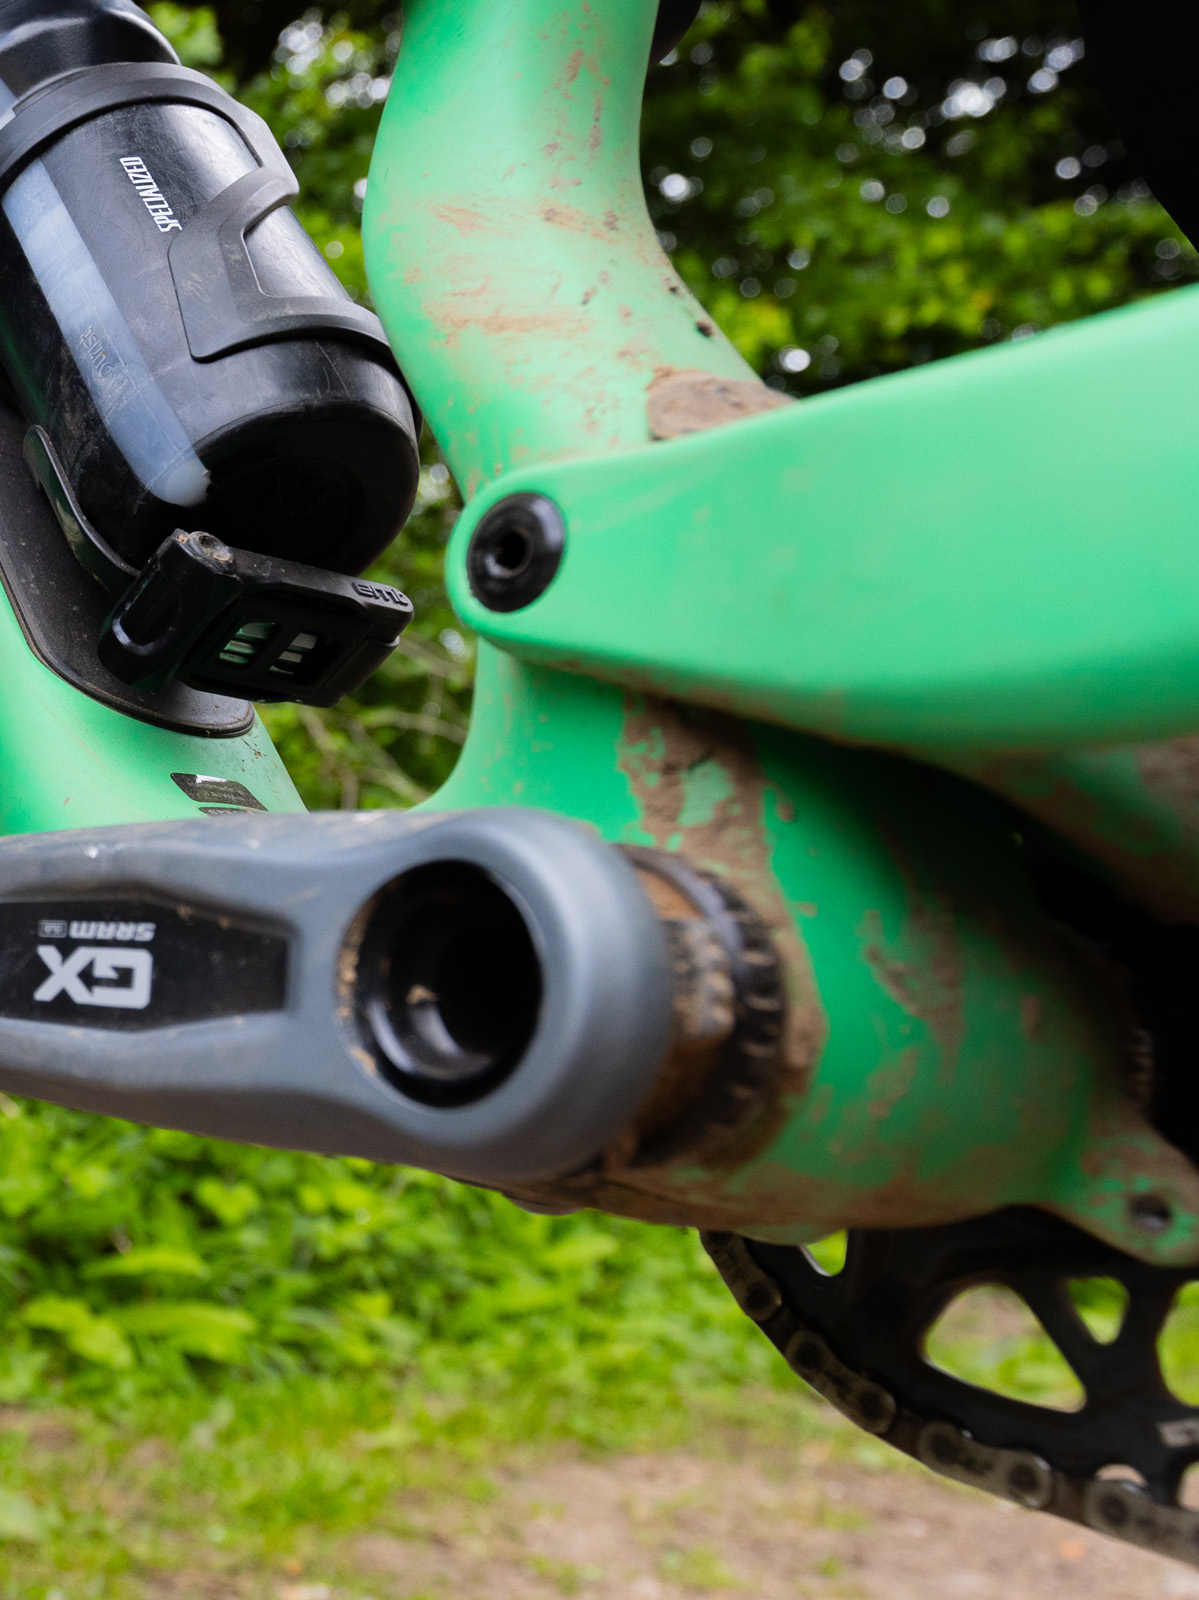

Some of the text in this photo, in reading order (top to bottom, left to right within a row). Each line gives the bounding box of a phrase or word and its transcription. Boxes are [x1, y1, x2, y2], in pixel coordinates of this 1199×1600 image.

[120, 156, 183, 232] SPECIALIZED
[69, 920, 157, 942] SRAM
[33, 944, 153, 1010] GX
